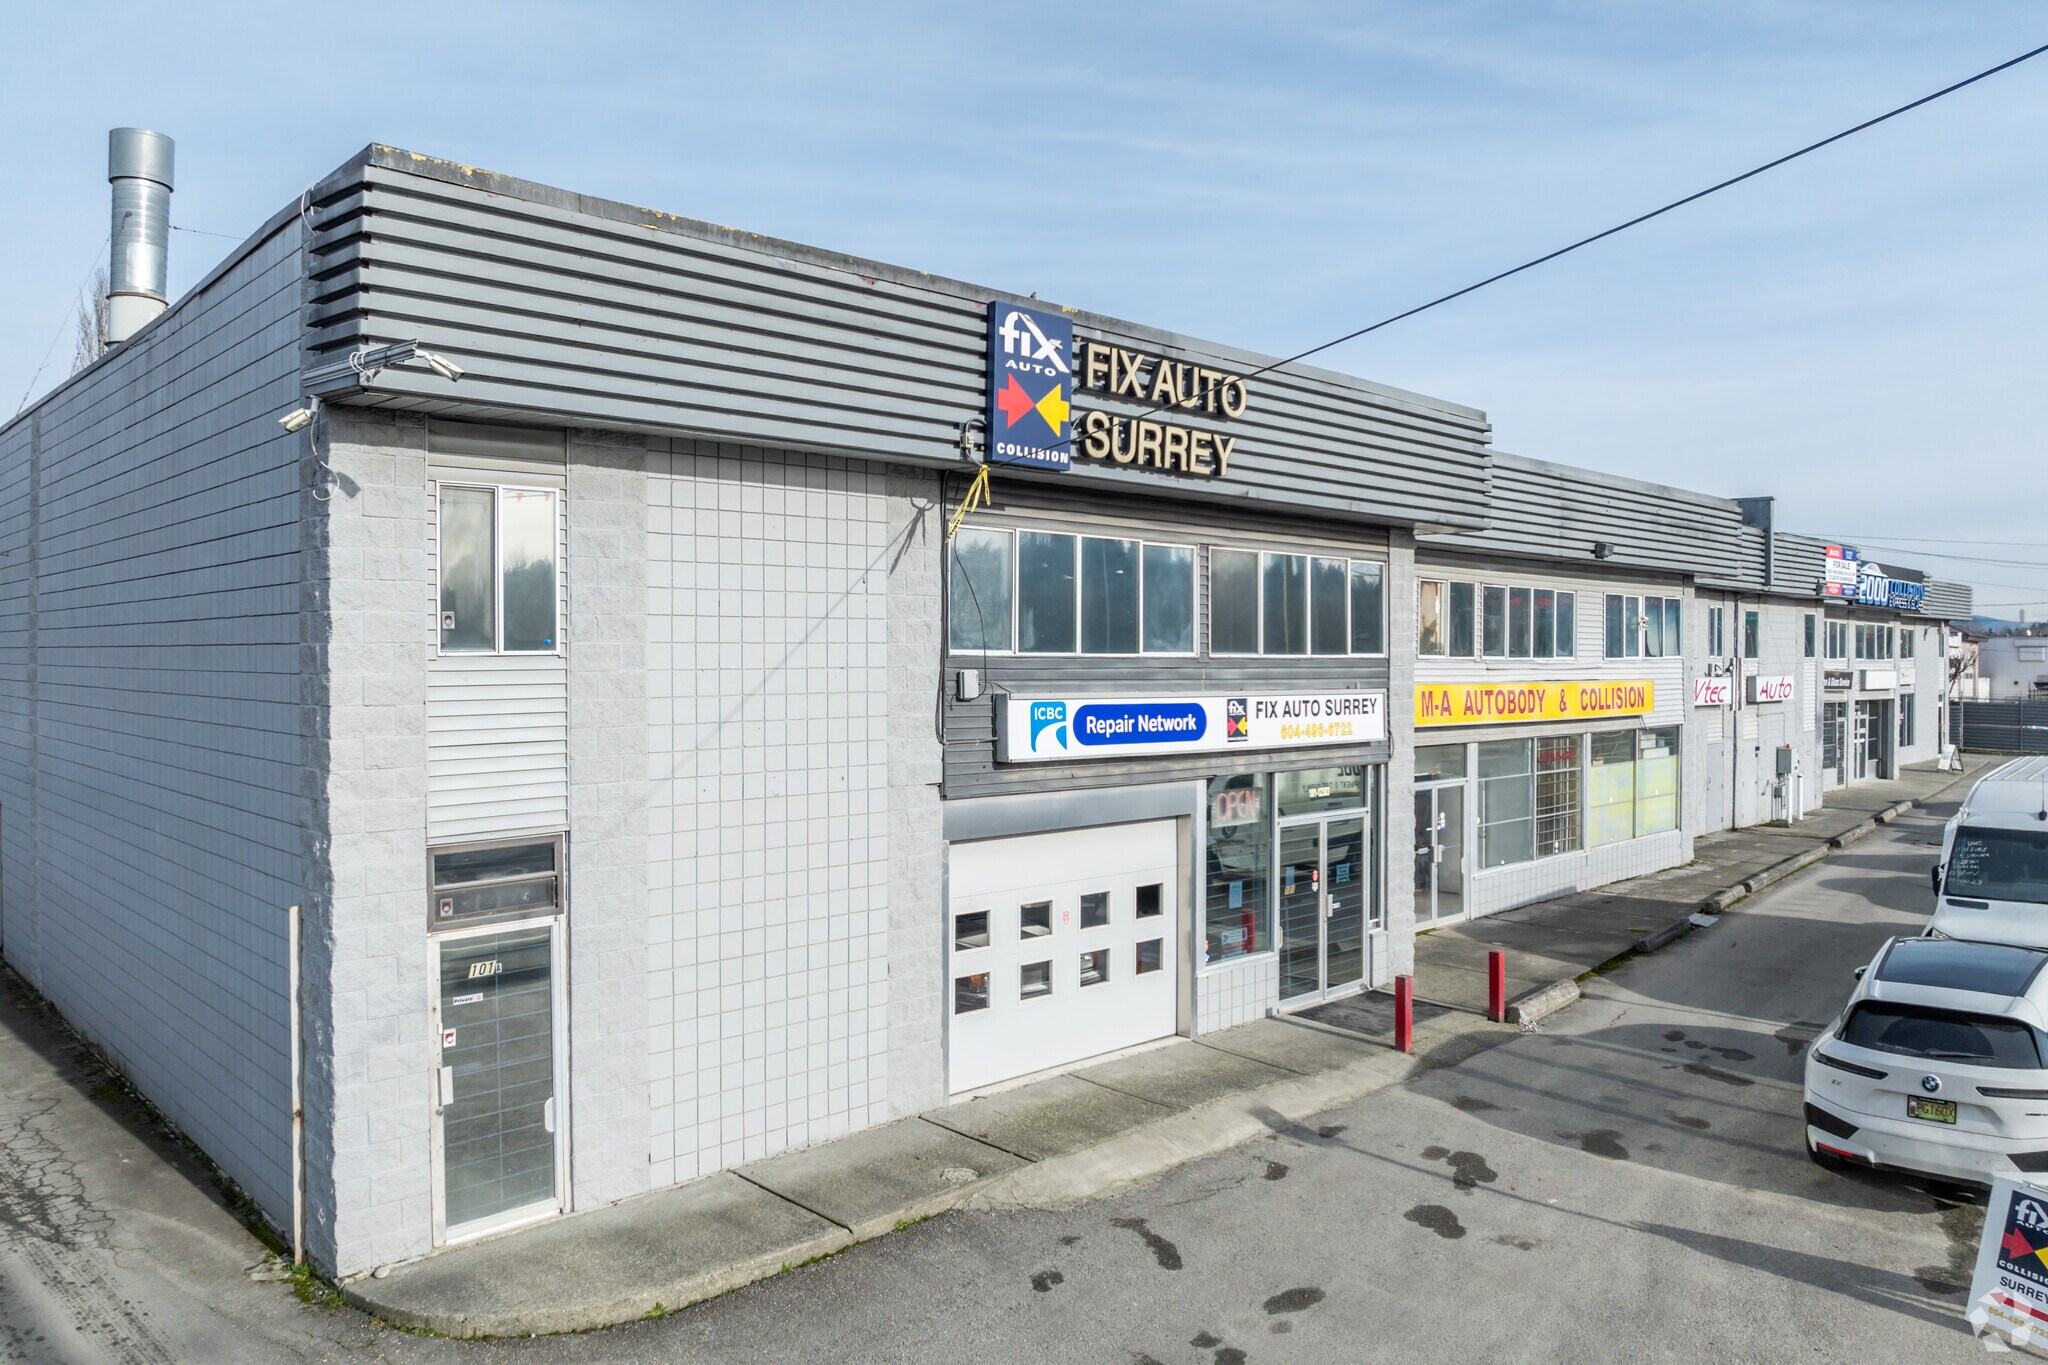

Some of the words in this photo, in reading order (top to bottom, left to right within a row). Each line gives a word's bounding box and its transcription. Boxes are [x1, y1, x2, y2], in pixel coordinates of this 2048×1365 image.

[1005, 359, 1057, 377] AUTO
[1086, 342, 1145, 399] FIX
[1151, 359, 1248, 418] AUTO
[996, 442, 1069, 465] COLLISION
[1085, 410, 1237, 477] SURREY
[1859, 574, 1889, 604] 2000
[1034, 706, 1063, 721] ICBC
[1256, 700, 1278, 719] FIX
[1282, 699, 1320, 718] AUTO
[1325, 698, 1377, 716] SURREY
[1421, 690, 1453, 718] M-A
[1463, 688, 1546, 716] AUTOBODY
[1559, 688, 1568, 713] &
[1580, 686, 1645, 712] COLLISION
[1086, 714, 1134, 739] Repair
[1137, 711, 1197, 733] Network
[1216, 790, 1256, 820] OPEN
[472, 961, 494, 977] 101
